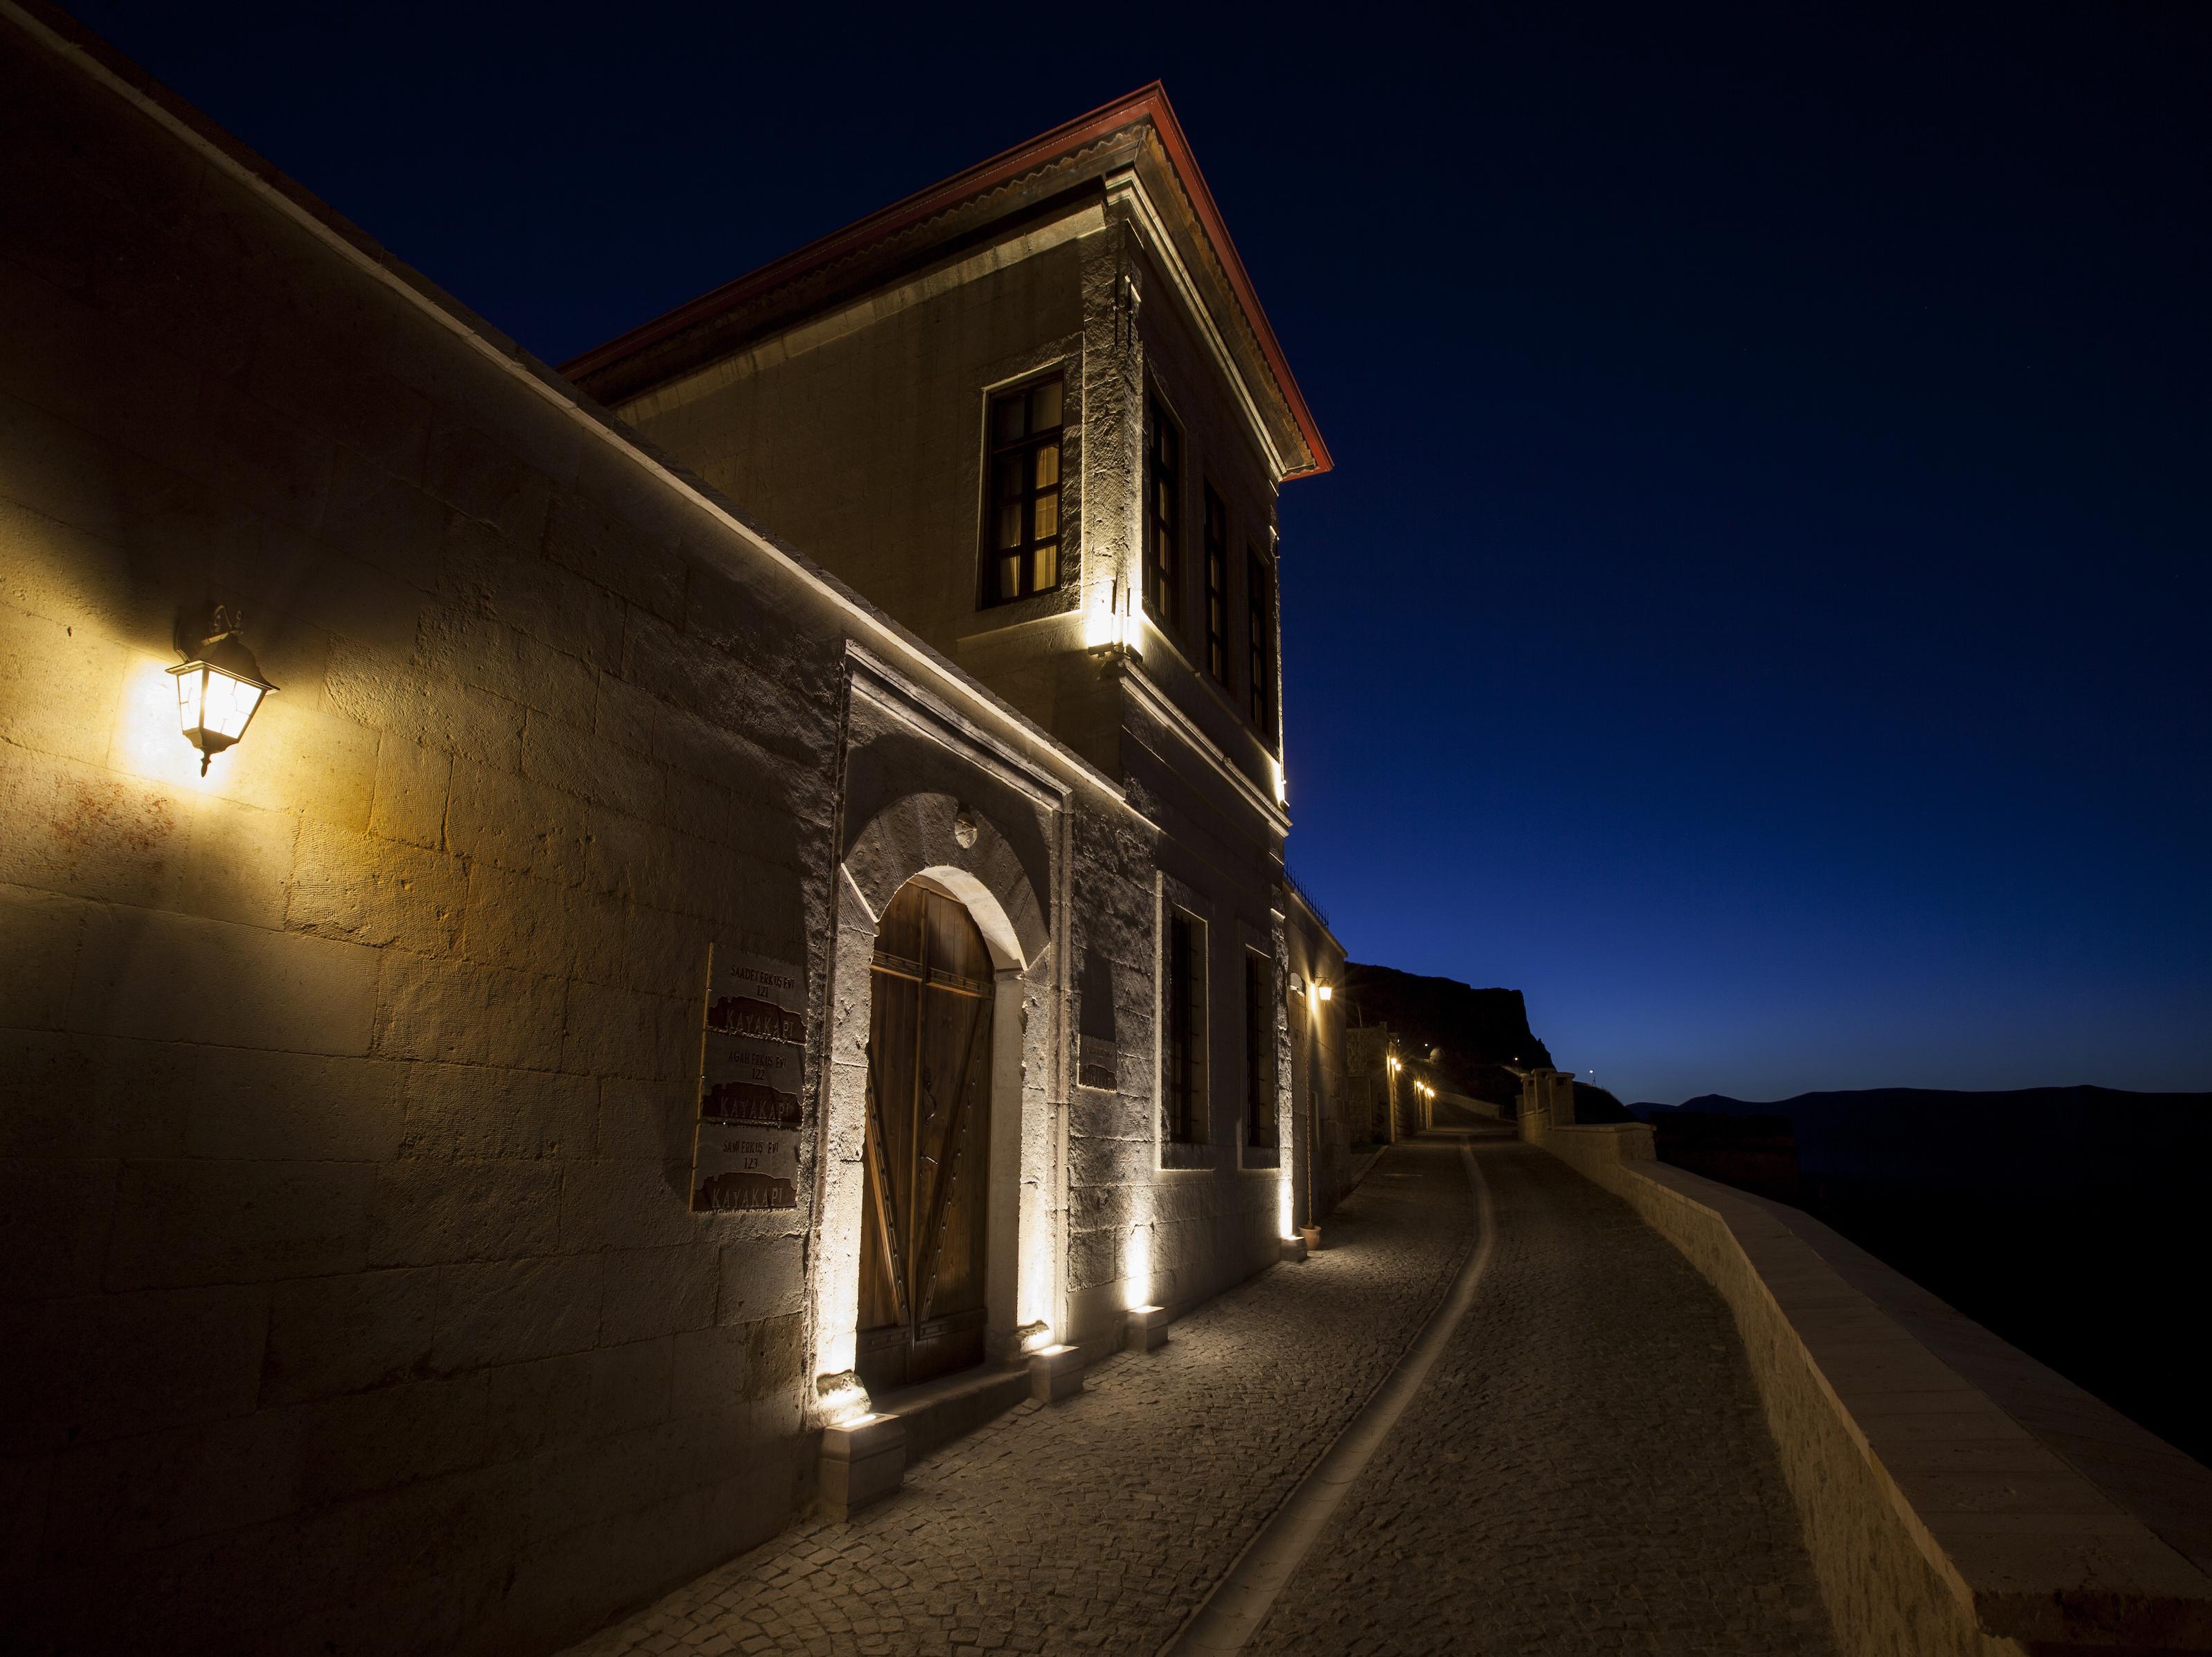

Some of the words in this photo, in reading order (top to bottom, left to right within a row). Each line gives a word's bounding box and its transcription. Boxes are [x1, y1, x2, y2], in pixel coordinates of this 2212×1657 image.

[752, 1068, 764, 1080] 122
[744, 1157, 758, 1169] 123
[711, 1186, 783, 1208] KAYAKAPI
